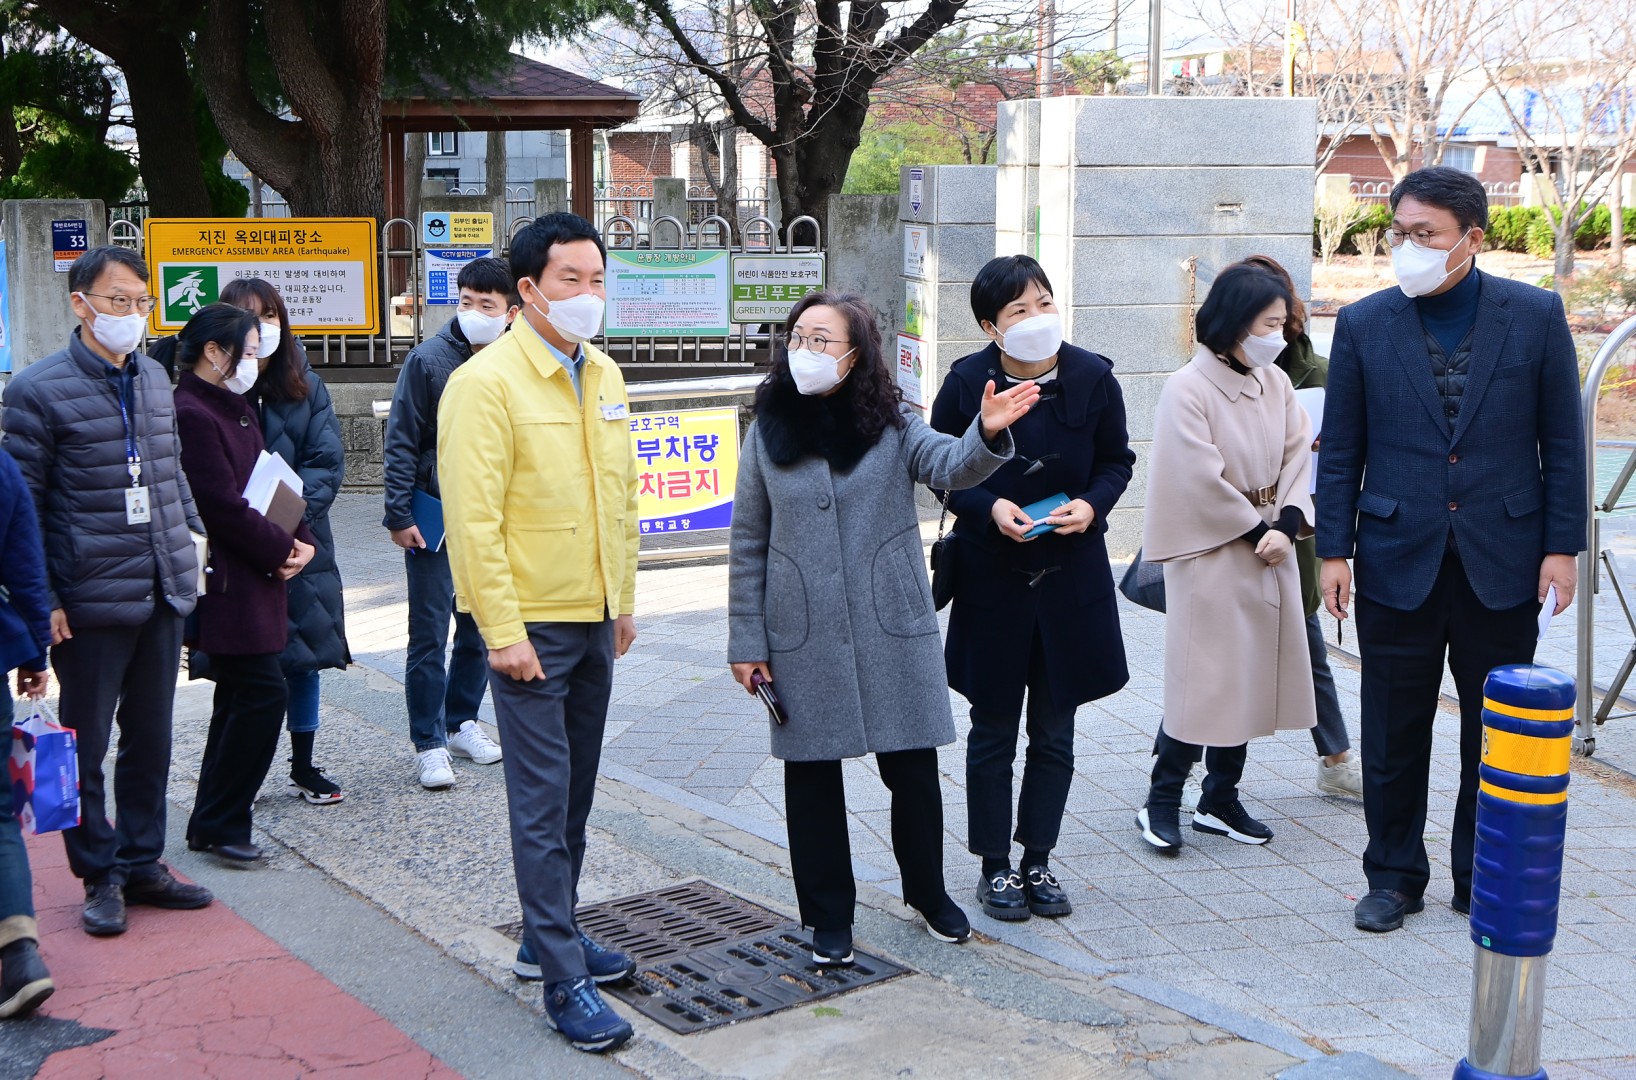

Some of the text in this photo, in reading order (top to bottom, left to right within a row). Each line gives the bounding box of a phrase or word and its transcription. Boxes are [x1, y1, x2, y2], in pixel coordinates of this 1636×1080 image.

[70, 236, 85, 248] 33
[199, 229, 323, 245] 지진 옥외대피장소
[172, 247, 350, 257] EMERGENCY ASSEMBLY AREA (Earthquake)
[637, 253, 697, 263] 운동장 개방안내
[235, 270, 347, 278] 이곳은 지진 발생에 대비하여
[737, 270, 819, 279] 어린이 식품안전 보호구역
[285, 284, 346, 293] 대피장소입니다.
[286, 308, 314, 317] 운대구
[769, 306, 792, 314] FOOD
[630, 416, 679, 431] 보호구역
[637, 434, 719, 465] 부차량
[639, 468, 719, 499] 차금지
[641, 519, 691, 532] 등학교장
